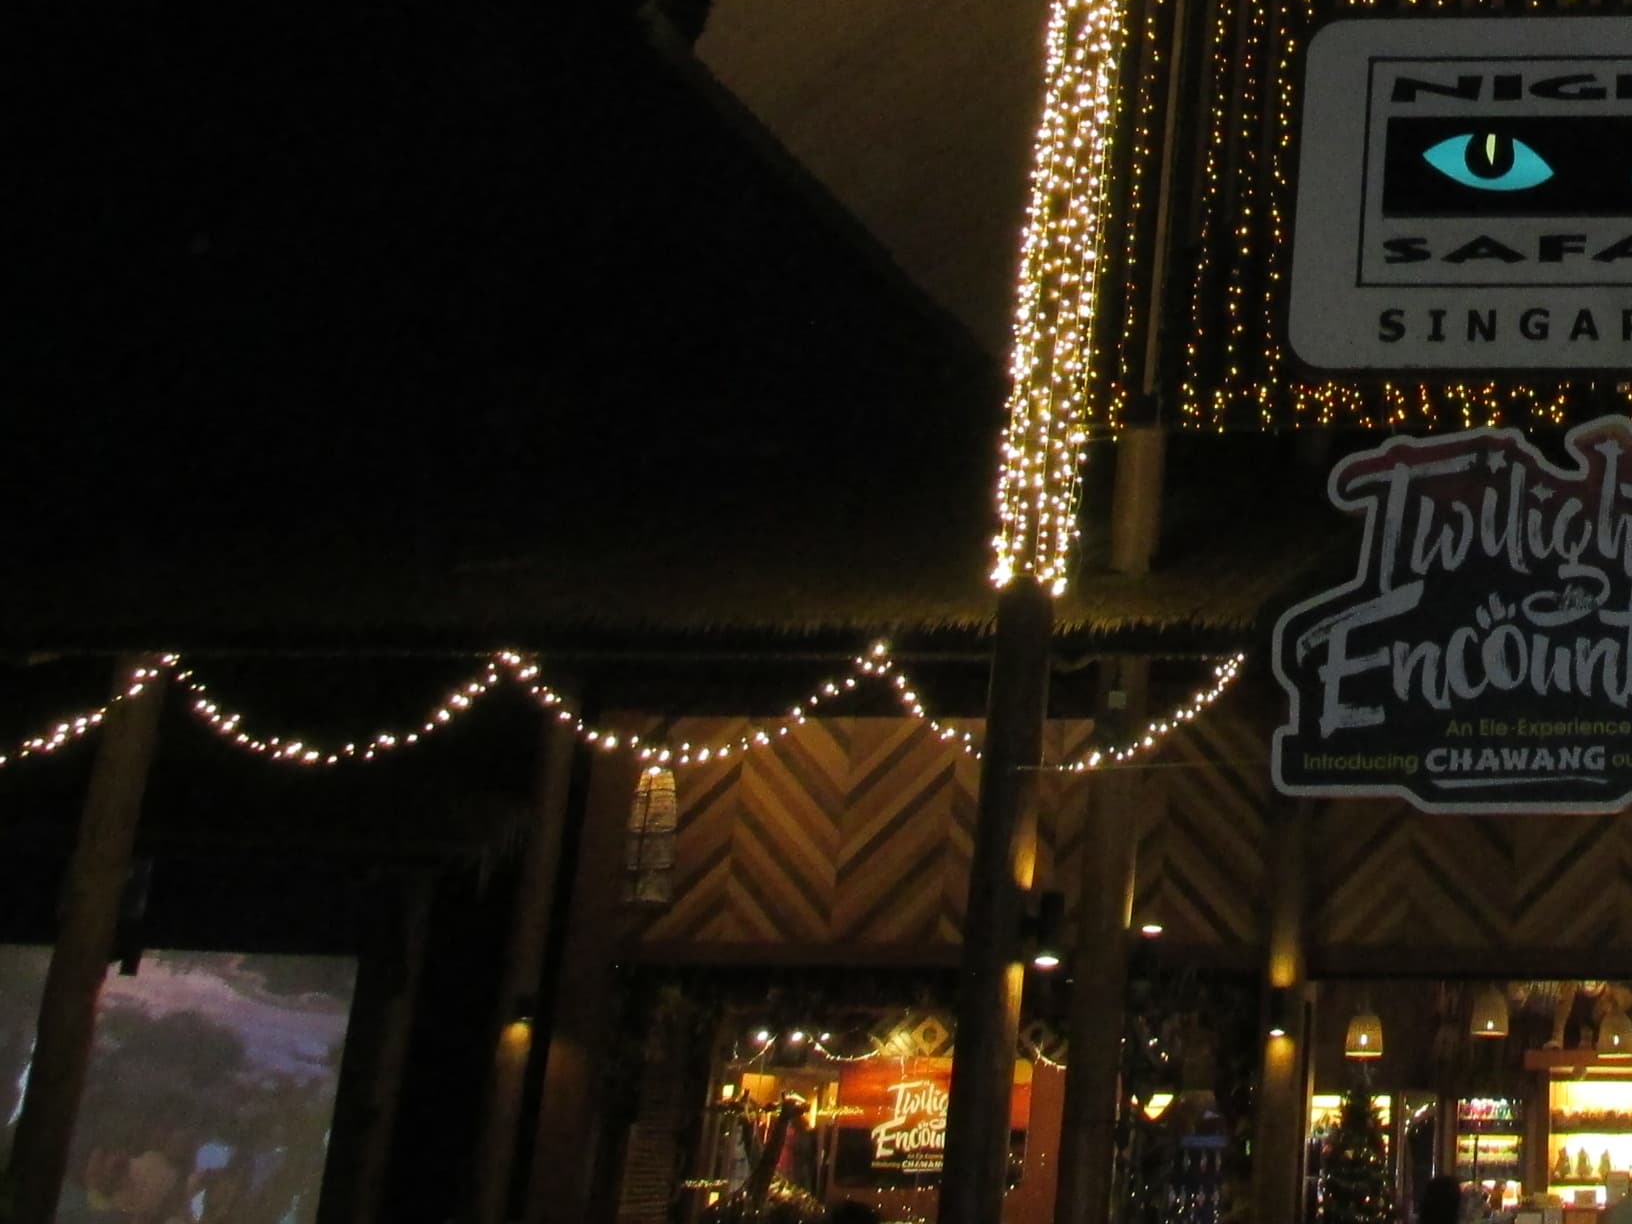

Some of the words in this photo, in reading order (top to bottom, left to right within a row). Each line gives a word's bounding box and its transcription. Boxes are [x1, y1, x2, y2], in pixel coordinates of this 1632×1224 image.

[1445, 719, 1472, 737] An
[1303, 753, 1420, 774] Introducing
[1424, 745, 1606, 772] CHAWANG
[887, 1079, 949, 1124] Twilig
